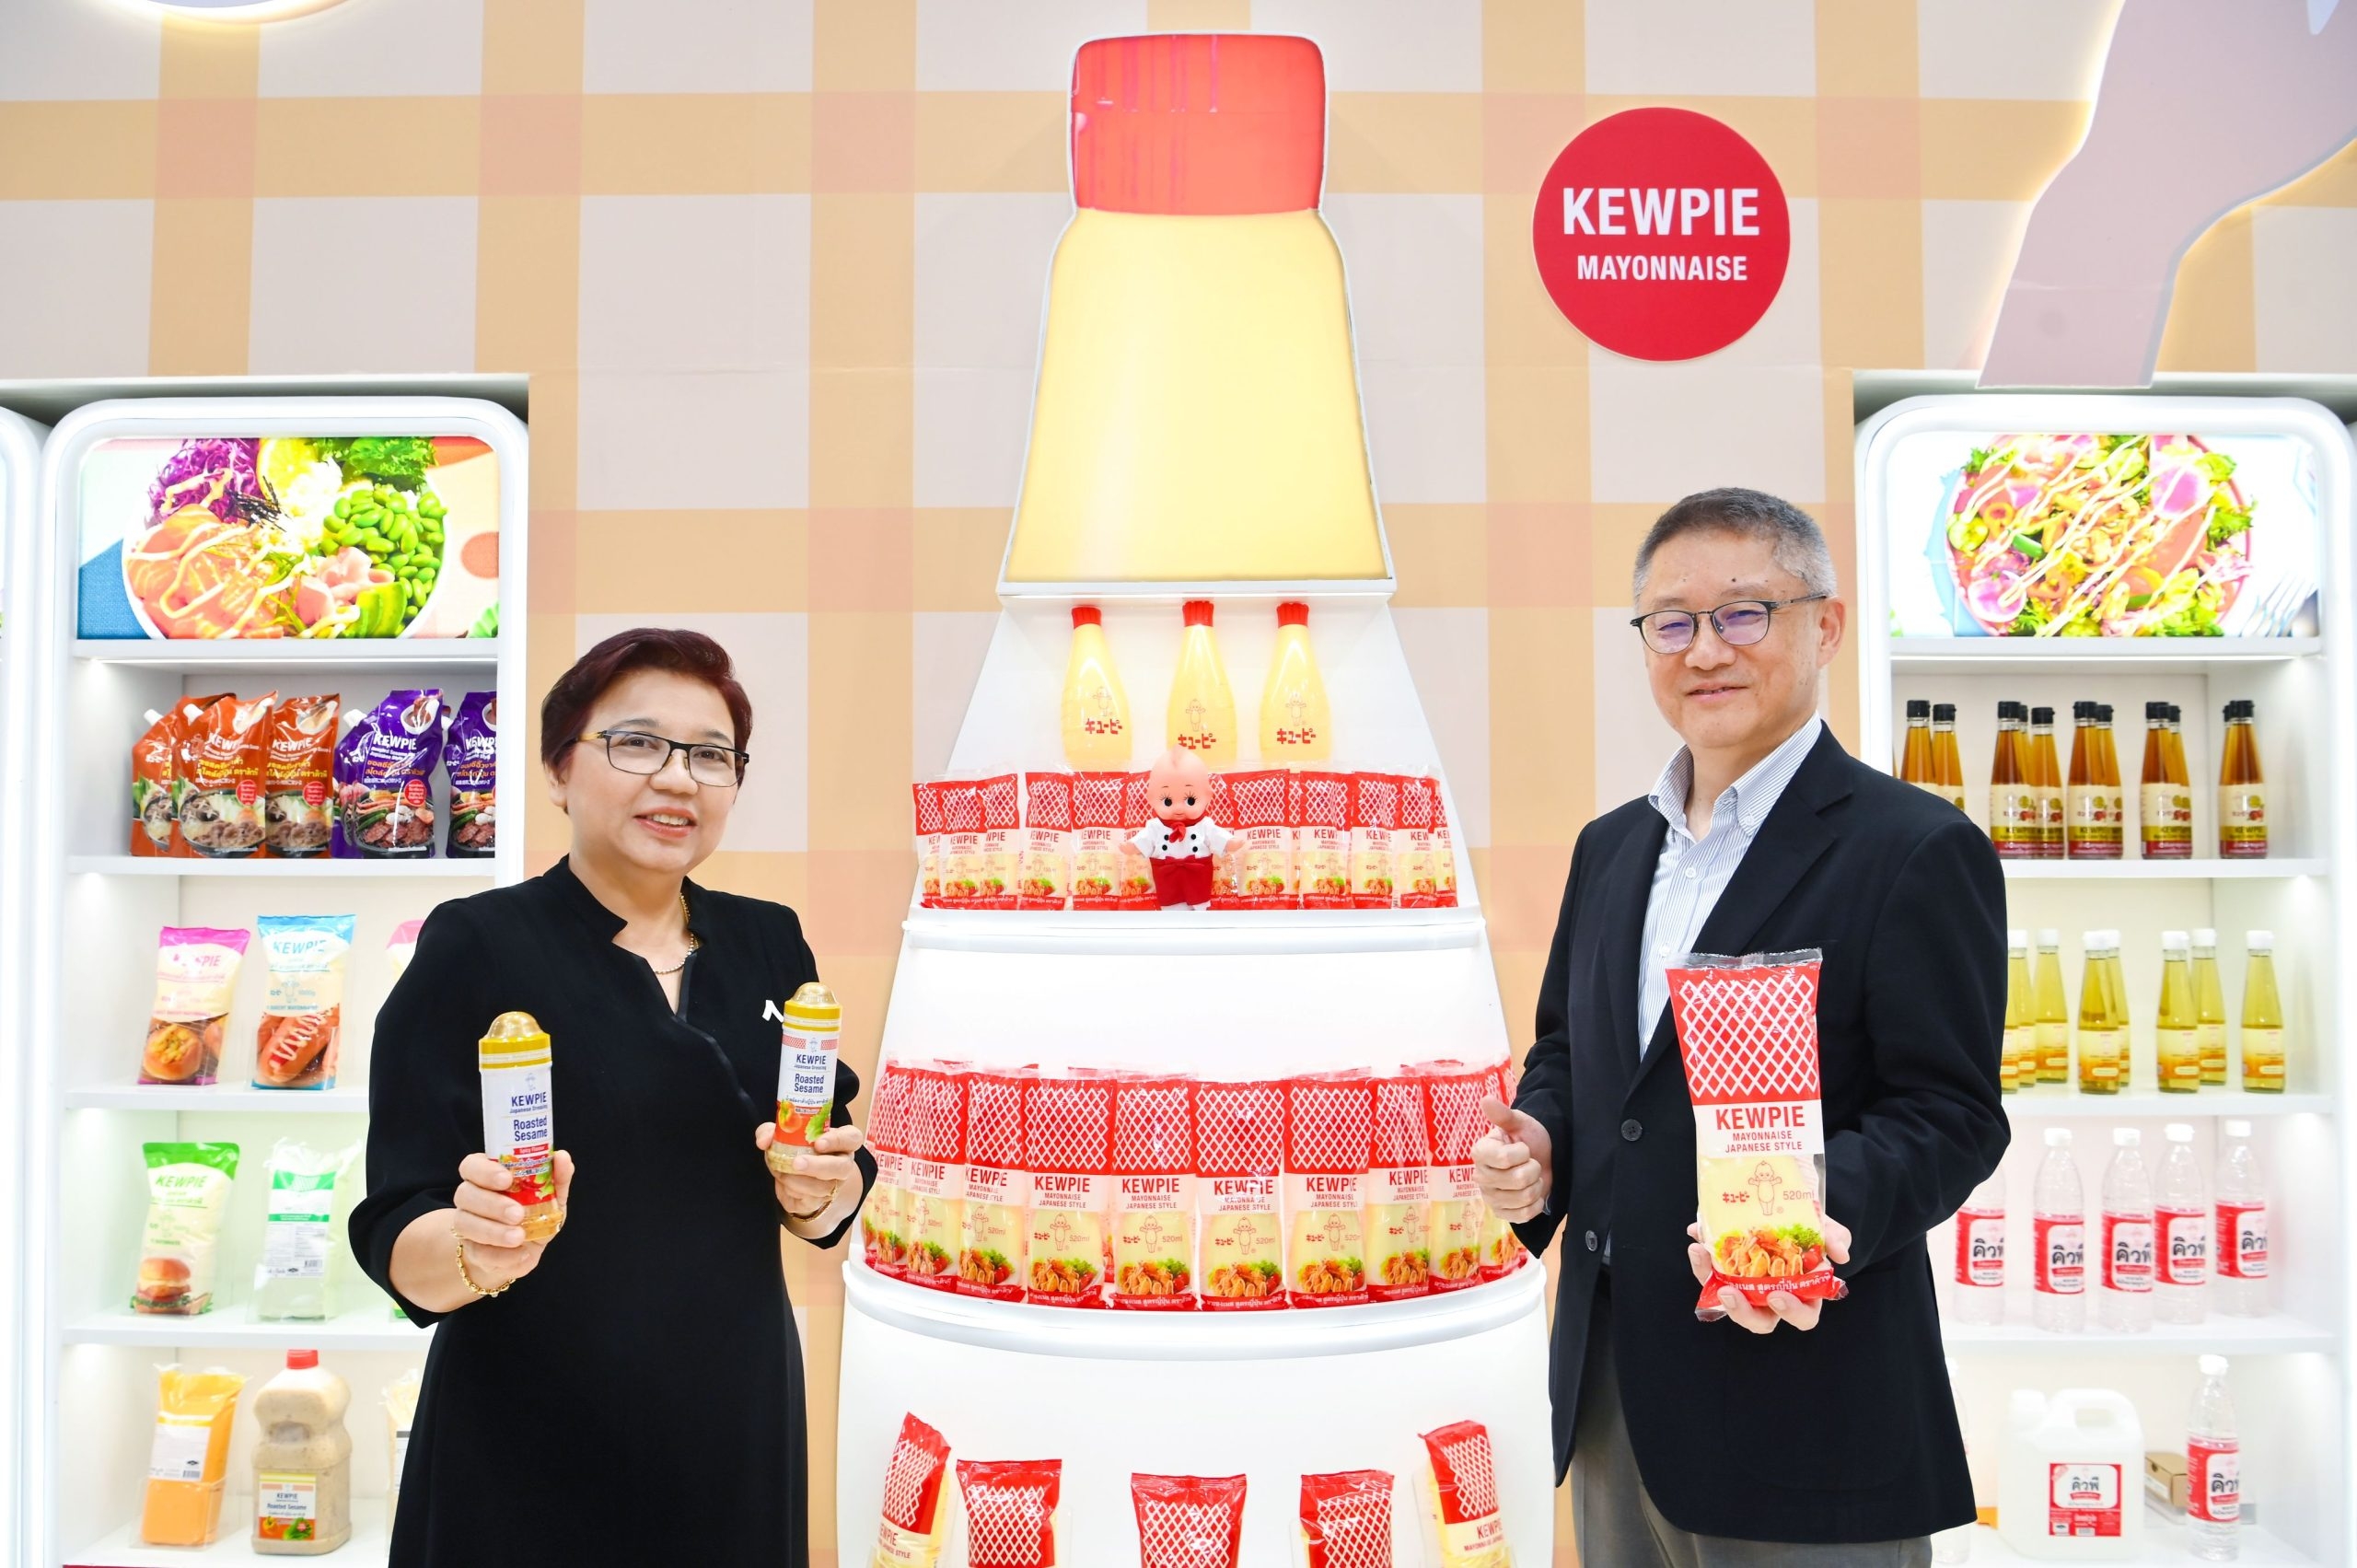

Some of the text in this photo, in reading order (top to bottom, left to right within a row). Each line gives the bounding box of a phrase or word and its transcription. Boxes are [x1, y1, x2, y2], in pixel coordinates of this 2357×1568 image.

[1563, 187, 1760, 236] KEWPIE
[1577, 255, 1747, 281] MAYONNAISE
[373, 735, 417, 750] KEWPIE
[1247, 829, 1282, 840] KEWPIE
[795, 1053, 827, 1065] KEWPIE
[795, 1073, 825, 1085] Roasted
[794, 1083, 824, 1093] Sesame
[511, 1091, 547, 1108] KEWPIE
[513, 1115, 548, 1131] Roasted
[1715, 1106, 1805, 1131] KEWPIE
[514, 1128, 548, 1142] Sesame
[1733, 1130, 1793, 1142] MAYONNAISE
[1724, 1141, 1803, 1153] JAPANESE STYLE
[911, 1160, 946, 1180] KEWPIE
[155, 1176, 208, 1189] KEWPIE
[1389, 1169, 1429, 1185] KEWPIE
[1035, 1176, 1091, 1193] KEWPIE
[1122, 1178, 1180, 1193] KEWPIE
[1306, 1177, 1357, 1192] KEWPIE
[966, 1191, 989, 1201] APANESE
[1044, 1191, 1081, 1201] MAYONNAISE
[1782, 1190, 1815, 1201] 520ml
[1039, 1199, 1086, 1209] JAPANESE STYLE
[1219, 1203, 1250, 1212] JAPANESE
[987, 1226, 1006, 1236] 520ml
[1069, 1234, 1090, 1242] 520ml
[1162, 1234, 1183, 1243] 520ml
[1255, 1237, 1276, 1245] 520ml
[2072, 1476, 2100, 1492] คิวพี
[895, 1550, 911, 1559] STYLE
